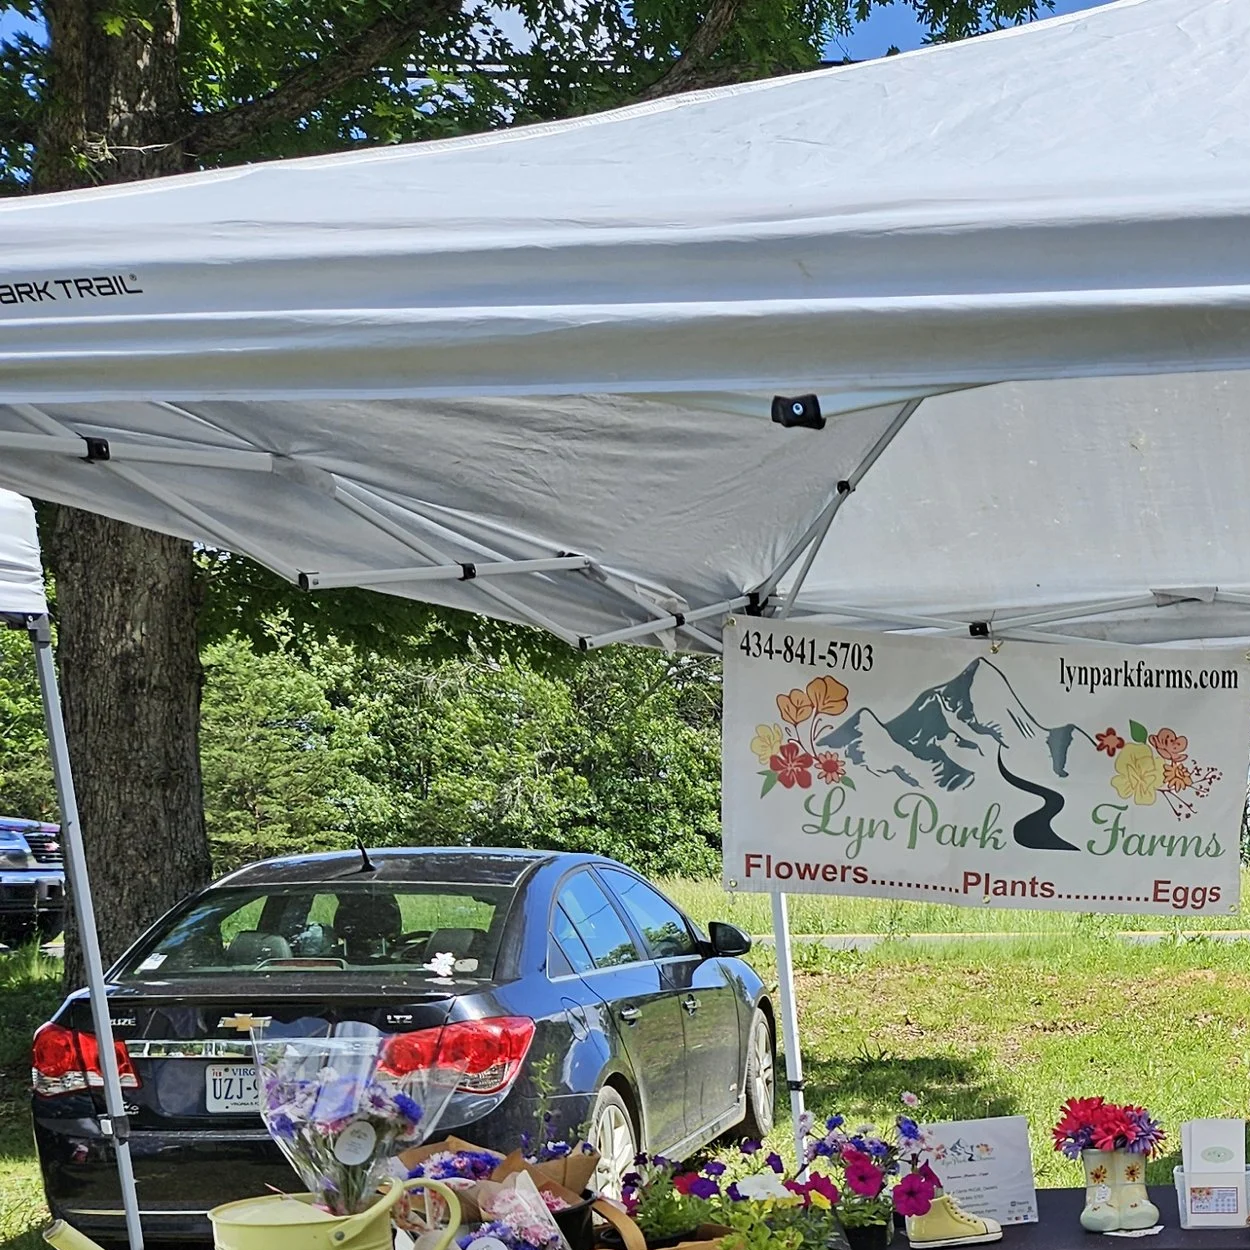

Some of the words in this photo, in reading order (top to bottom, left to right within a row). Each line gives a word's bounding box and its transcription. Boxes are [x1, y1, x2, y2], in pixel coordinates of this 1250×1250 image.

[0, 279, 57, 304] ARK
[740, 630, 874, 671] 434-841-5703
[1060, 657, 1238, 693] lynparkfarms.com
[802, 786, 896, 859] Lyn
[894, 792, 1006, 850] Park
[1086, 803, 1226, 858] Farms
[231, 1067, 256, 1077] VIRG
[212, 1078, 259, 1100] UZJ-9
